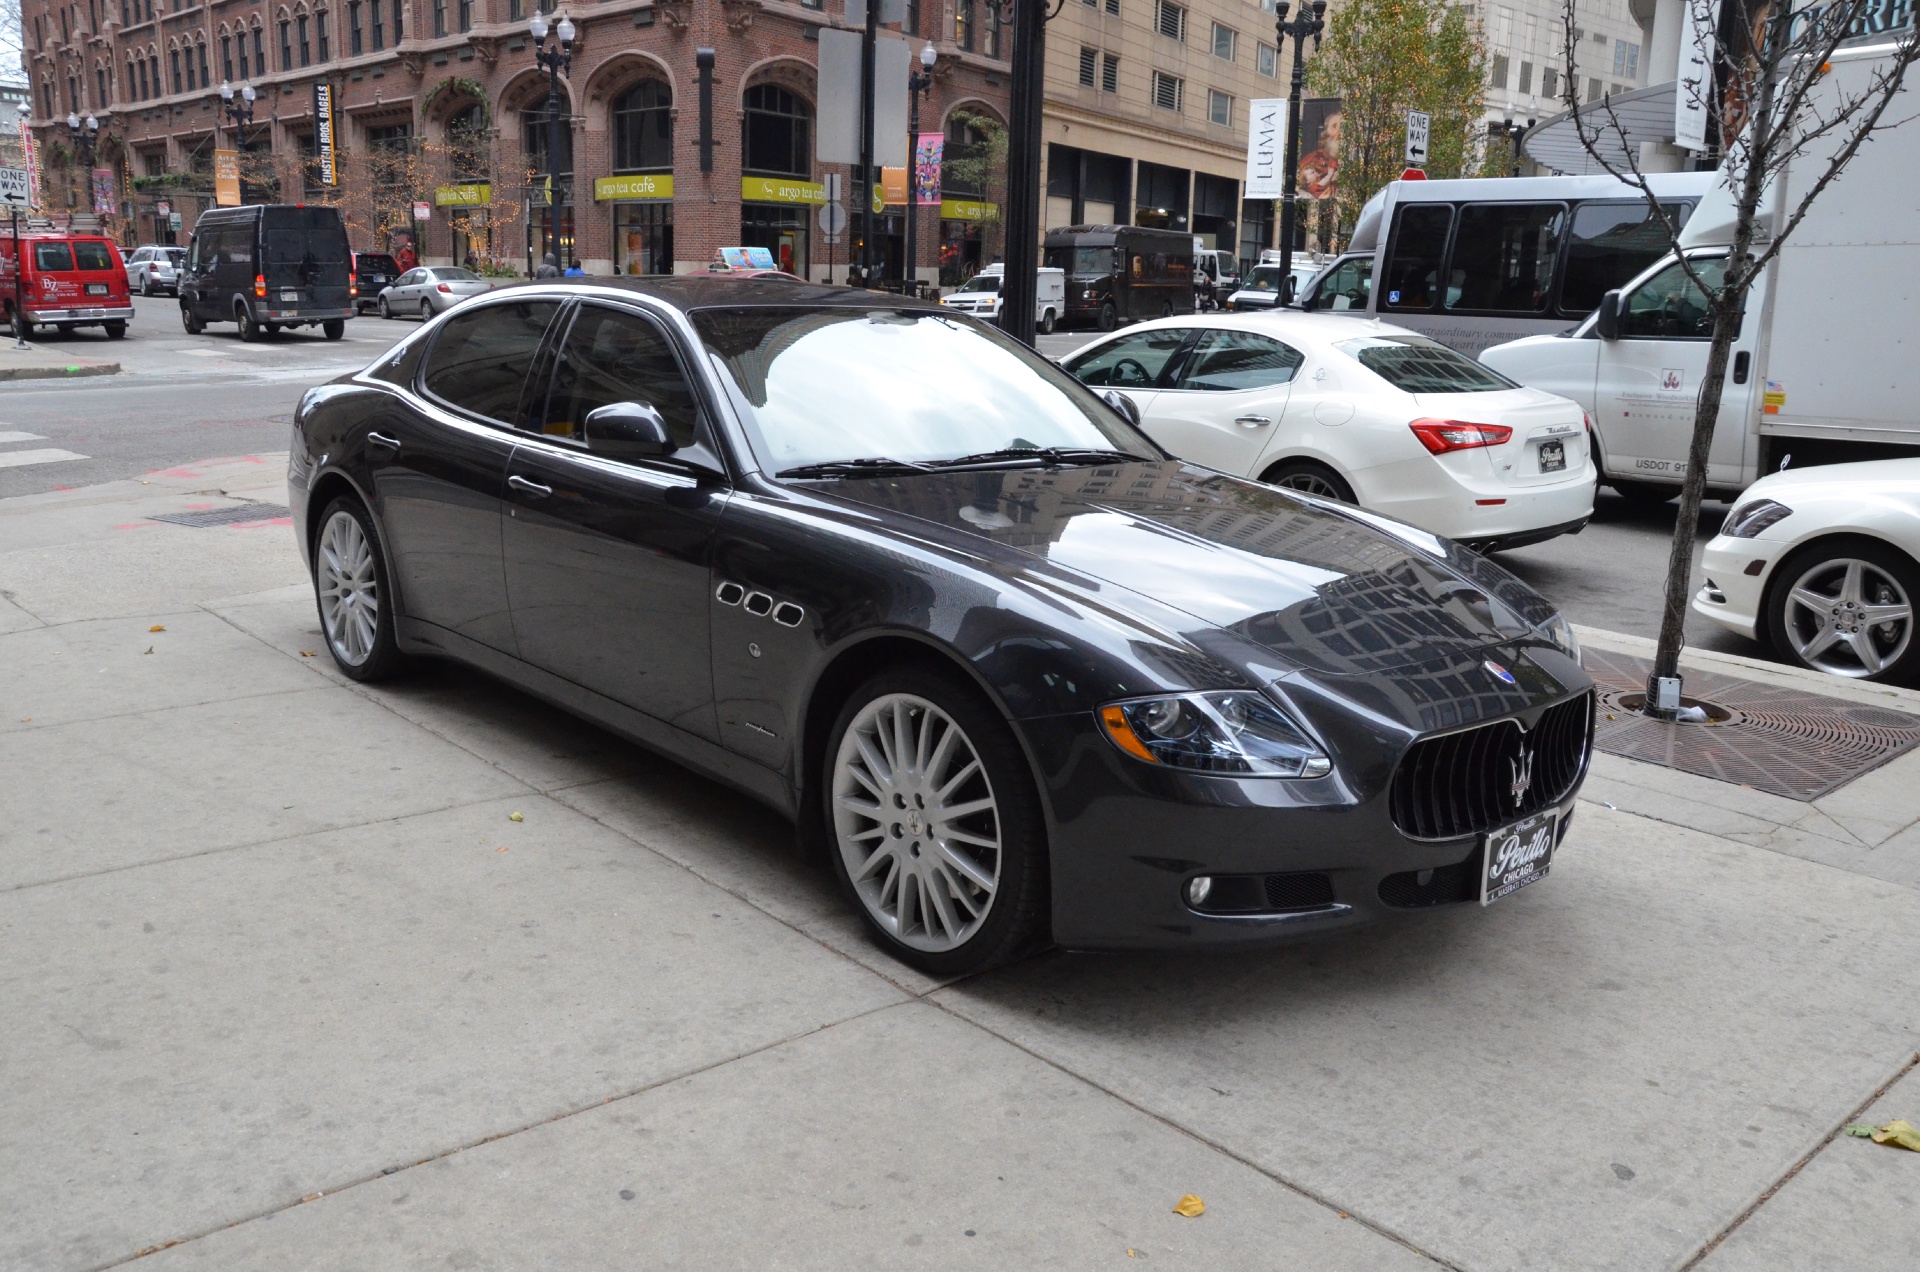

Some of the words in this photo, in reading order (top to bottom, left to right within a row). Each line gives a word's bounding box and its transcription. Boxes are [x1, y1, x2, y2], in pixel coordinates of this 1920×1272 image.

[317, 85, 329, 119] BAGELS
[1410, 115, 1428, 130] ONE
[319, 119, 331, 144] BROS.
[1409, 129, 1428, 143] WAY
[1256, 111, 1277, 179] LUMA
[1, 170, 25, 181] ONE
[1, 181, 25, 191] WAY
[616, 182, 628, 193] tea
[630, 176, 655, 193] café
[779, 186, 800, 200] argo
[802, 187, 812, 199] tea
[42, 278, 58, 291] BZ
[1416, 325, 1482, 339] extraordinary
[1484, 329, 1536, 341] communit
[1476, 340, 1488, 351] of
[1656, 393, 1699, 401] Woodworkin
[1541, 446, 1563, 463] Perillo
[1636, 459, 1671, 471] USDOT
[1489, 826, 1551, 879] Perillo
[1503, 862, 1534, 885] CHICAGO
[1497, 881, 1520, 898] MASERATI
[1521, 871, 1540, 887] CHICAGO
